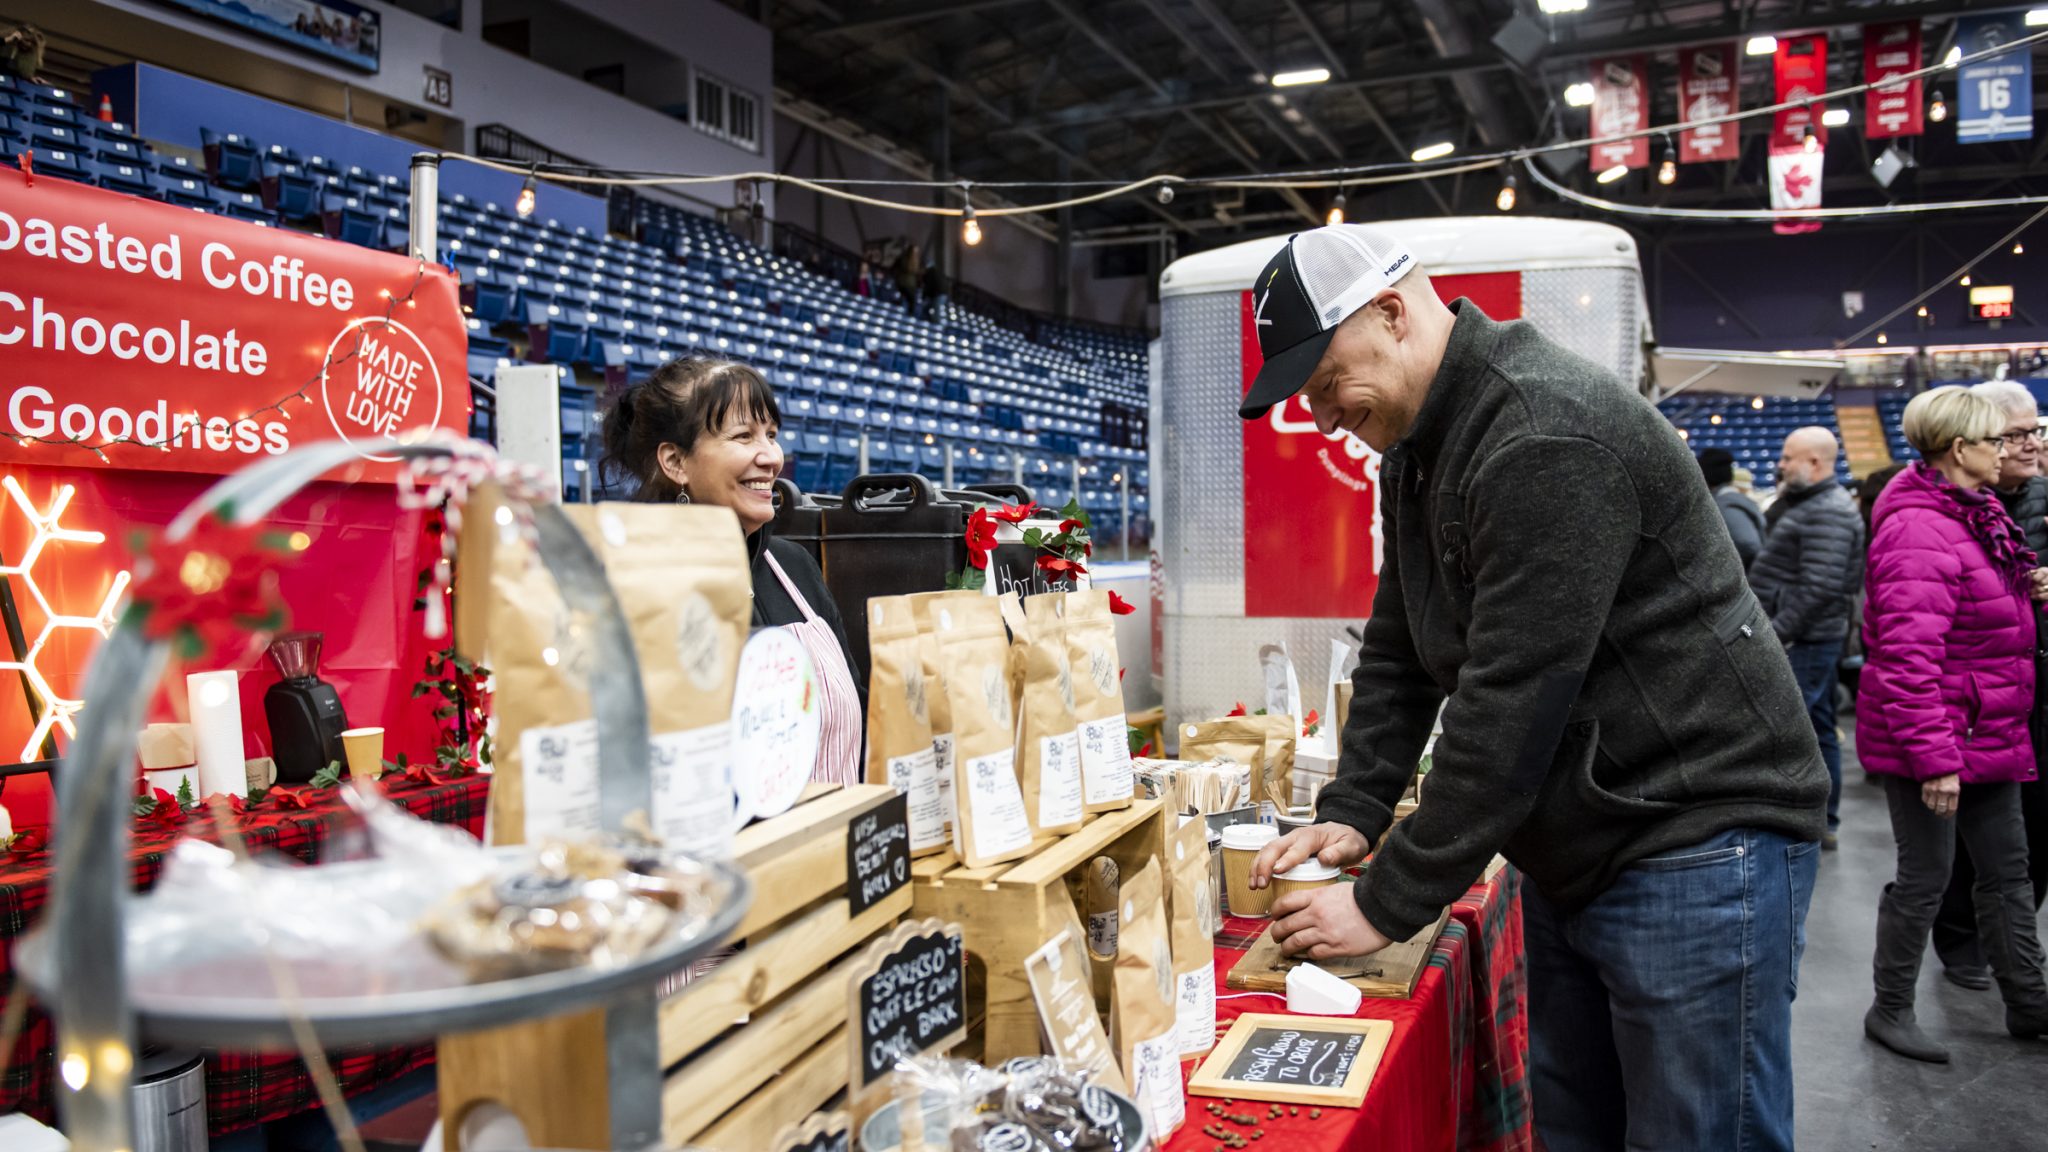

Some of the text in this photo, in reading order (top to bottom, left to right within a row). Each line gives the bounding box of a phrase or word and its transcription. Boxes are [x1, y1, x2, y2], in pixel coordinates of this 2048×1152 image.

[1978, 78, 2011, 111] 16
[202, 243, 354, 312] Coffee
[1384, 254, 1409, 277] HEAD
[0, 291, 267, 376] Chocolate
[359, 332, 423, 390] MADE
[346, 390, 402, 441] LOVE
[358, 361, 412, 417] WITH
[8, 386, 289, 455] Goodness
[1000, 564, 1030, 600] HOT
[872, 947, 945, 1003] ESPRESSO
[867, 981, 926, 1035] COFFEE
[918, 1000, 958, 1038] BARK
[1279, 1066, 1300, 1080] TO
